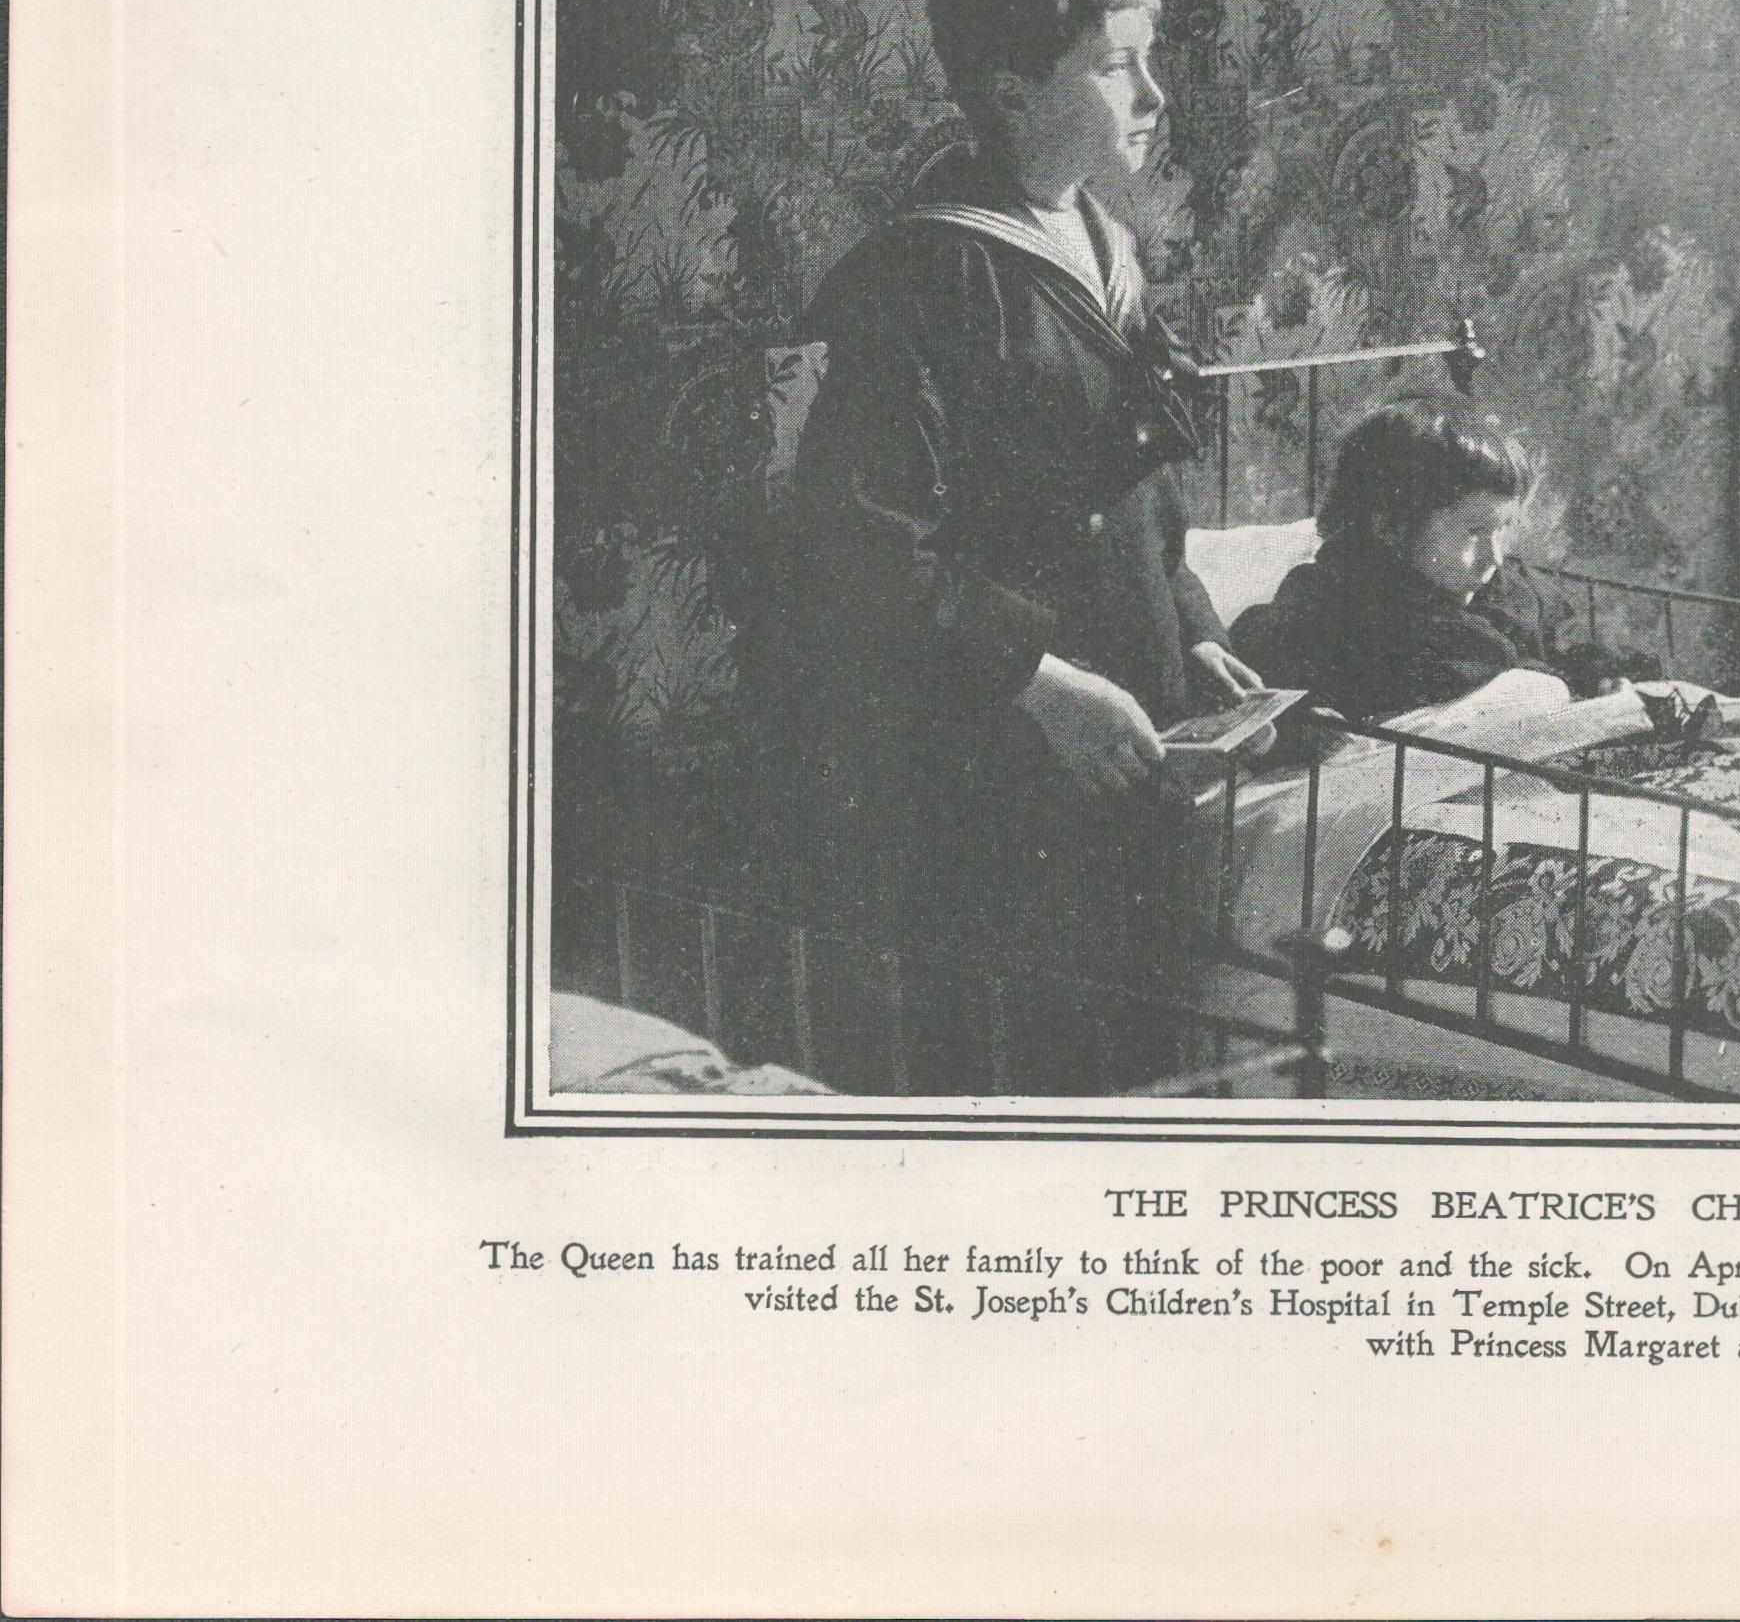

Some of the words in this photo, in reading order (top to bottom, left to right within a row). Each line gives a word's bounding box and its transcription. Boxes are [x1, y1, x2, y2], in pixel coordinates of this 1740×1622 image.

[1104, 1189, 1188, 1217] THE
[1220, 1190, 1398, 1219] PRINCESS
[1431, 1191, 1656, 1221] BEATRICE'S
[479, 1239, 544, 1270] The
[560, 1242, 655, 1278] Queen
[672, 1243, 719, 1271] has
[735, 1243, 836, 1272] trained
[852, 1244, 888, 1272] all
[903, 1245, 950, 1273] her
[966, 1245, 1063, 1279] family
[1079, 1250, 1107, 1275] to
[1123, 1248, 1200, 1275] think
[1216, 1248, 1244, 1276] of
[1260, 1249, 1304, 1276] the
[1320, 1258, 1384, 1285] poor
[1399, 1250, 1453, 1278] and
[1468, 1251, 1513, 1279] the
[1528, 1251, 1592, 1279] sick.
[1625, 1251, 1671, 1279] On
[744, 1284, 839, 1312] visited
[855, 1284, 899, 1313] the
[914, 1284, 954, 1314] St.
[971, 1285, 1088, 1322] Joseph's
[1106, 1287, 1253, 1316] Children's
[1270, 1289, 1391, 1325] Hospital
[1407, 1291, 1436, 1317] in
[1452, 1288, 1569, 1326] Temple
[1585, 1291, 1676, 1323] Street,
[1366, 1329, 1435, 1357] with
[1450, 1328, 1567, 1359] Princess
[1584, 1330, 1720, 1366] Margaret
